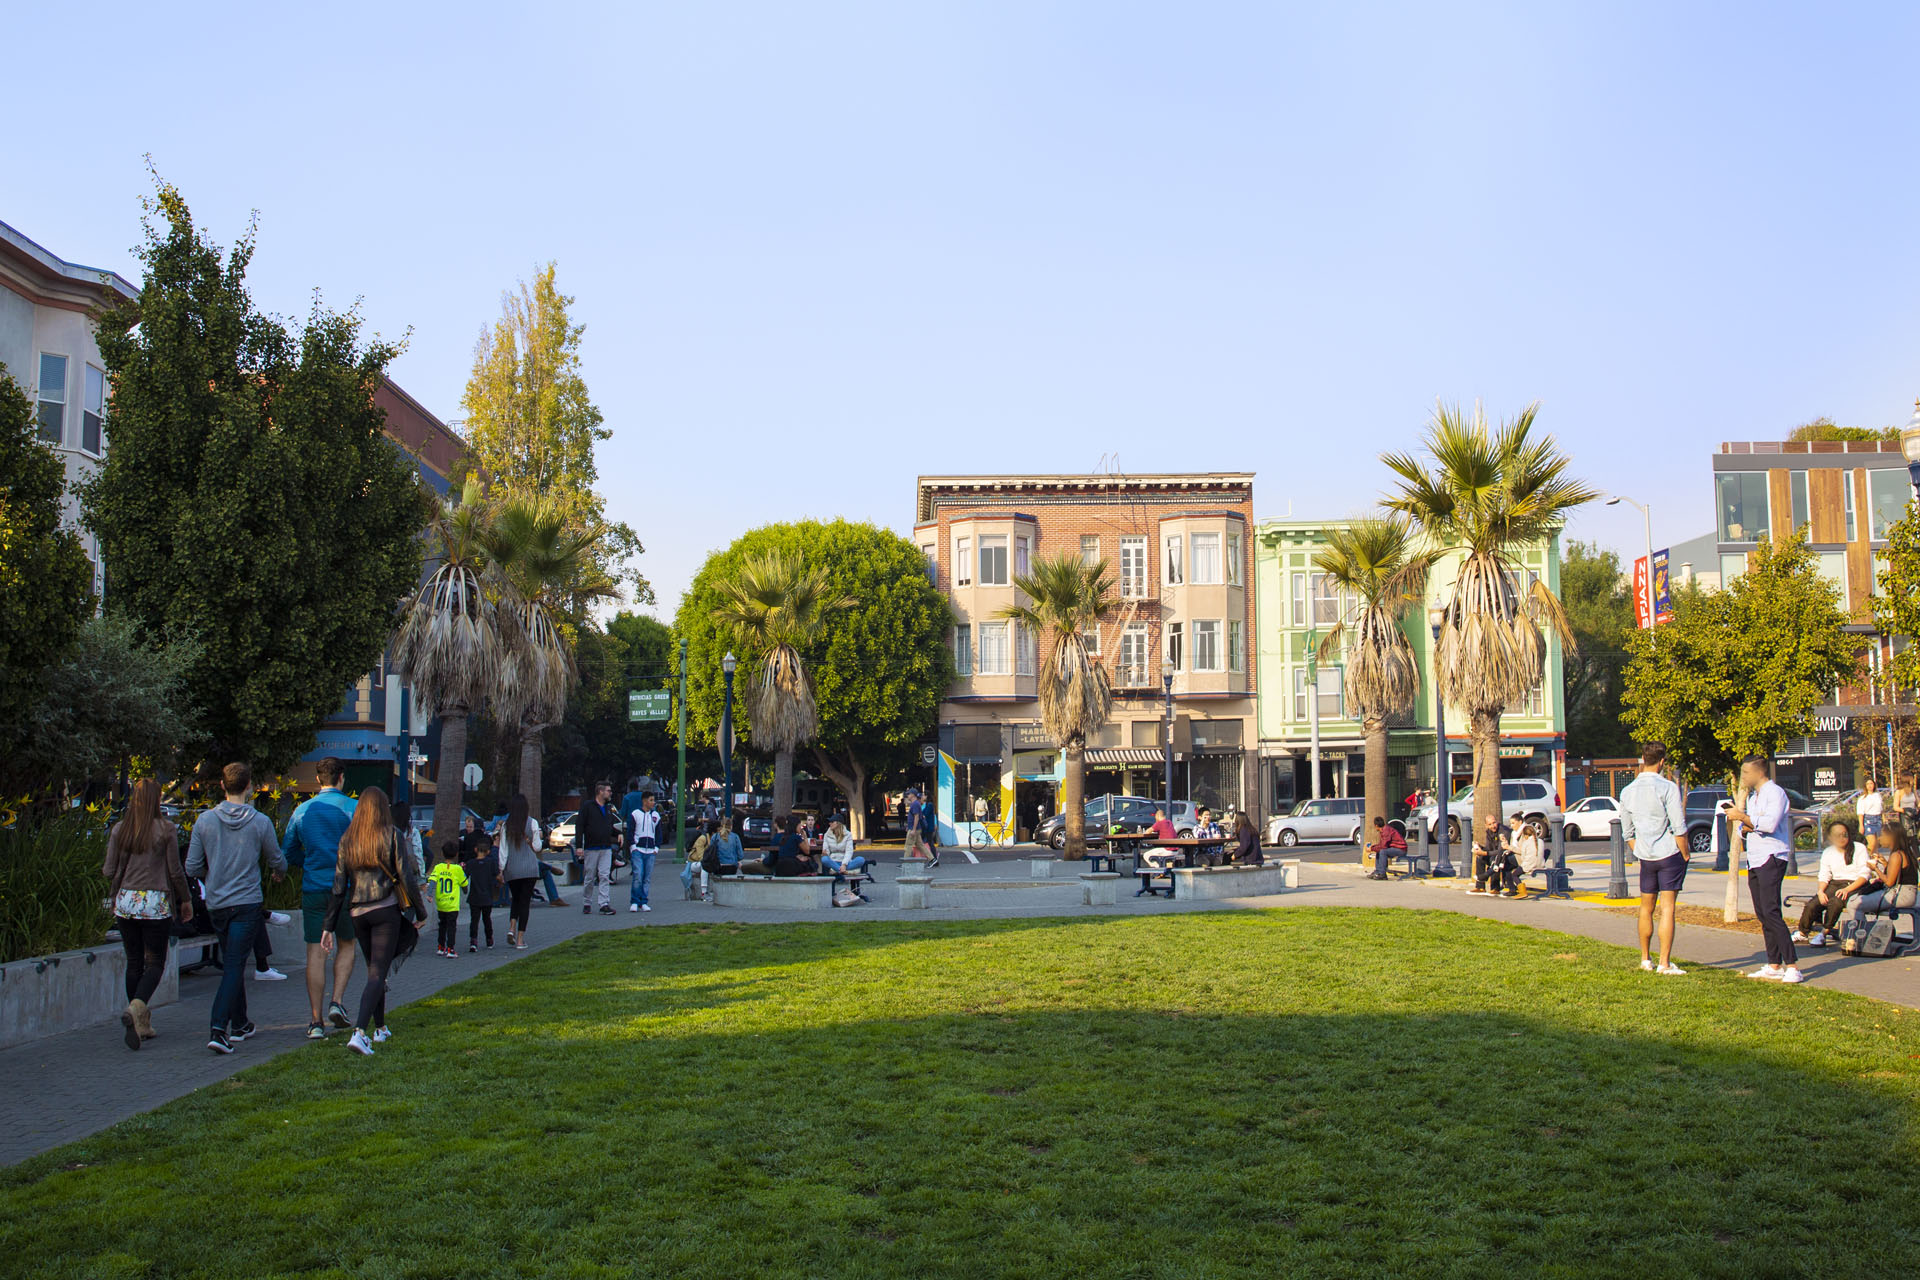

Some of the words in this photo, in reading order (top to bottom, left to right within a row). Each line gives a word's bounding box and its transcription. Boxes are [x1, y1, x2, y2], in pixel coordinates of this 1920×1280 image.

[1638, 560, 1649, 630] SFJAZZ
[1329, 751, 1346, 760] TACKS
[1814, 770, 1835, 779] URBAN
[1814, 778, 1837, 787] REMEDY
[439, 877, 453, 894] 10
